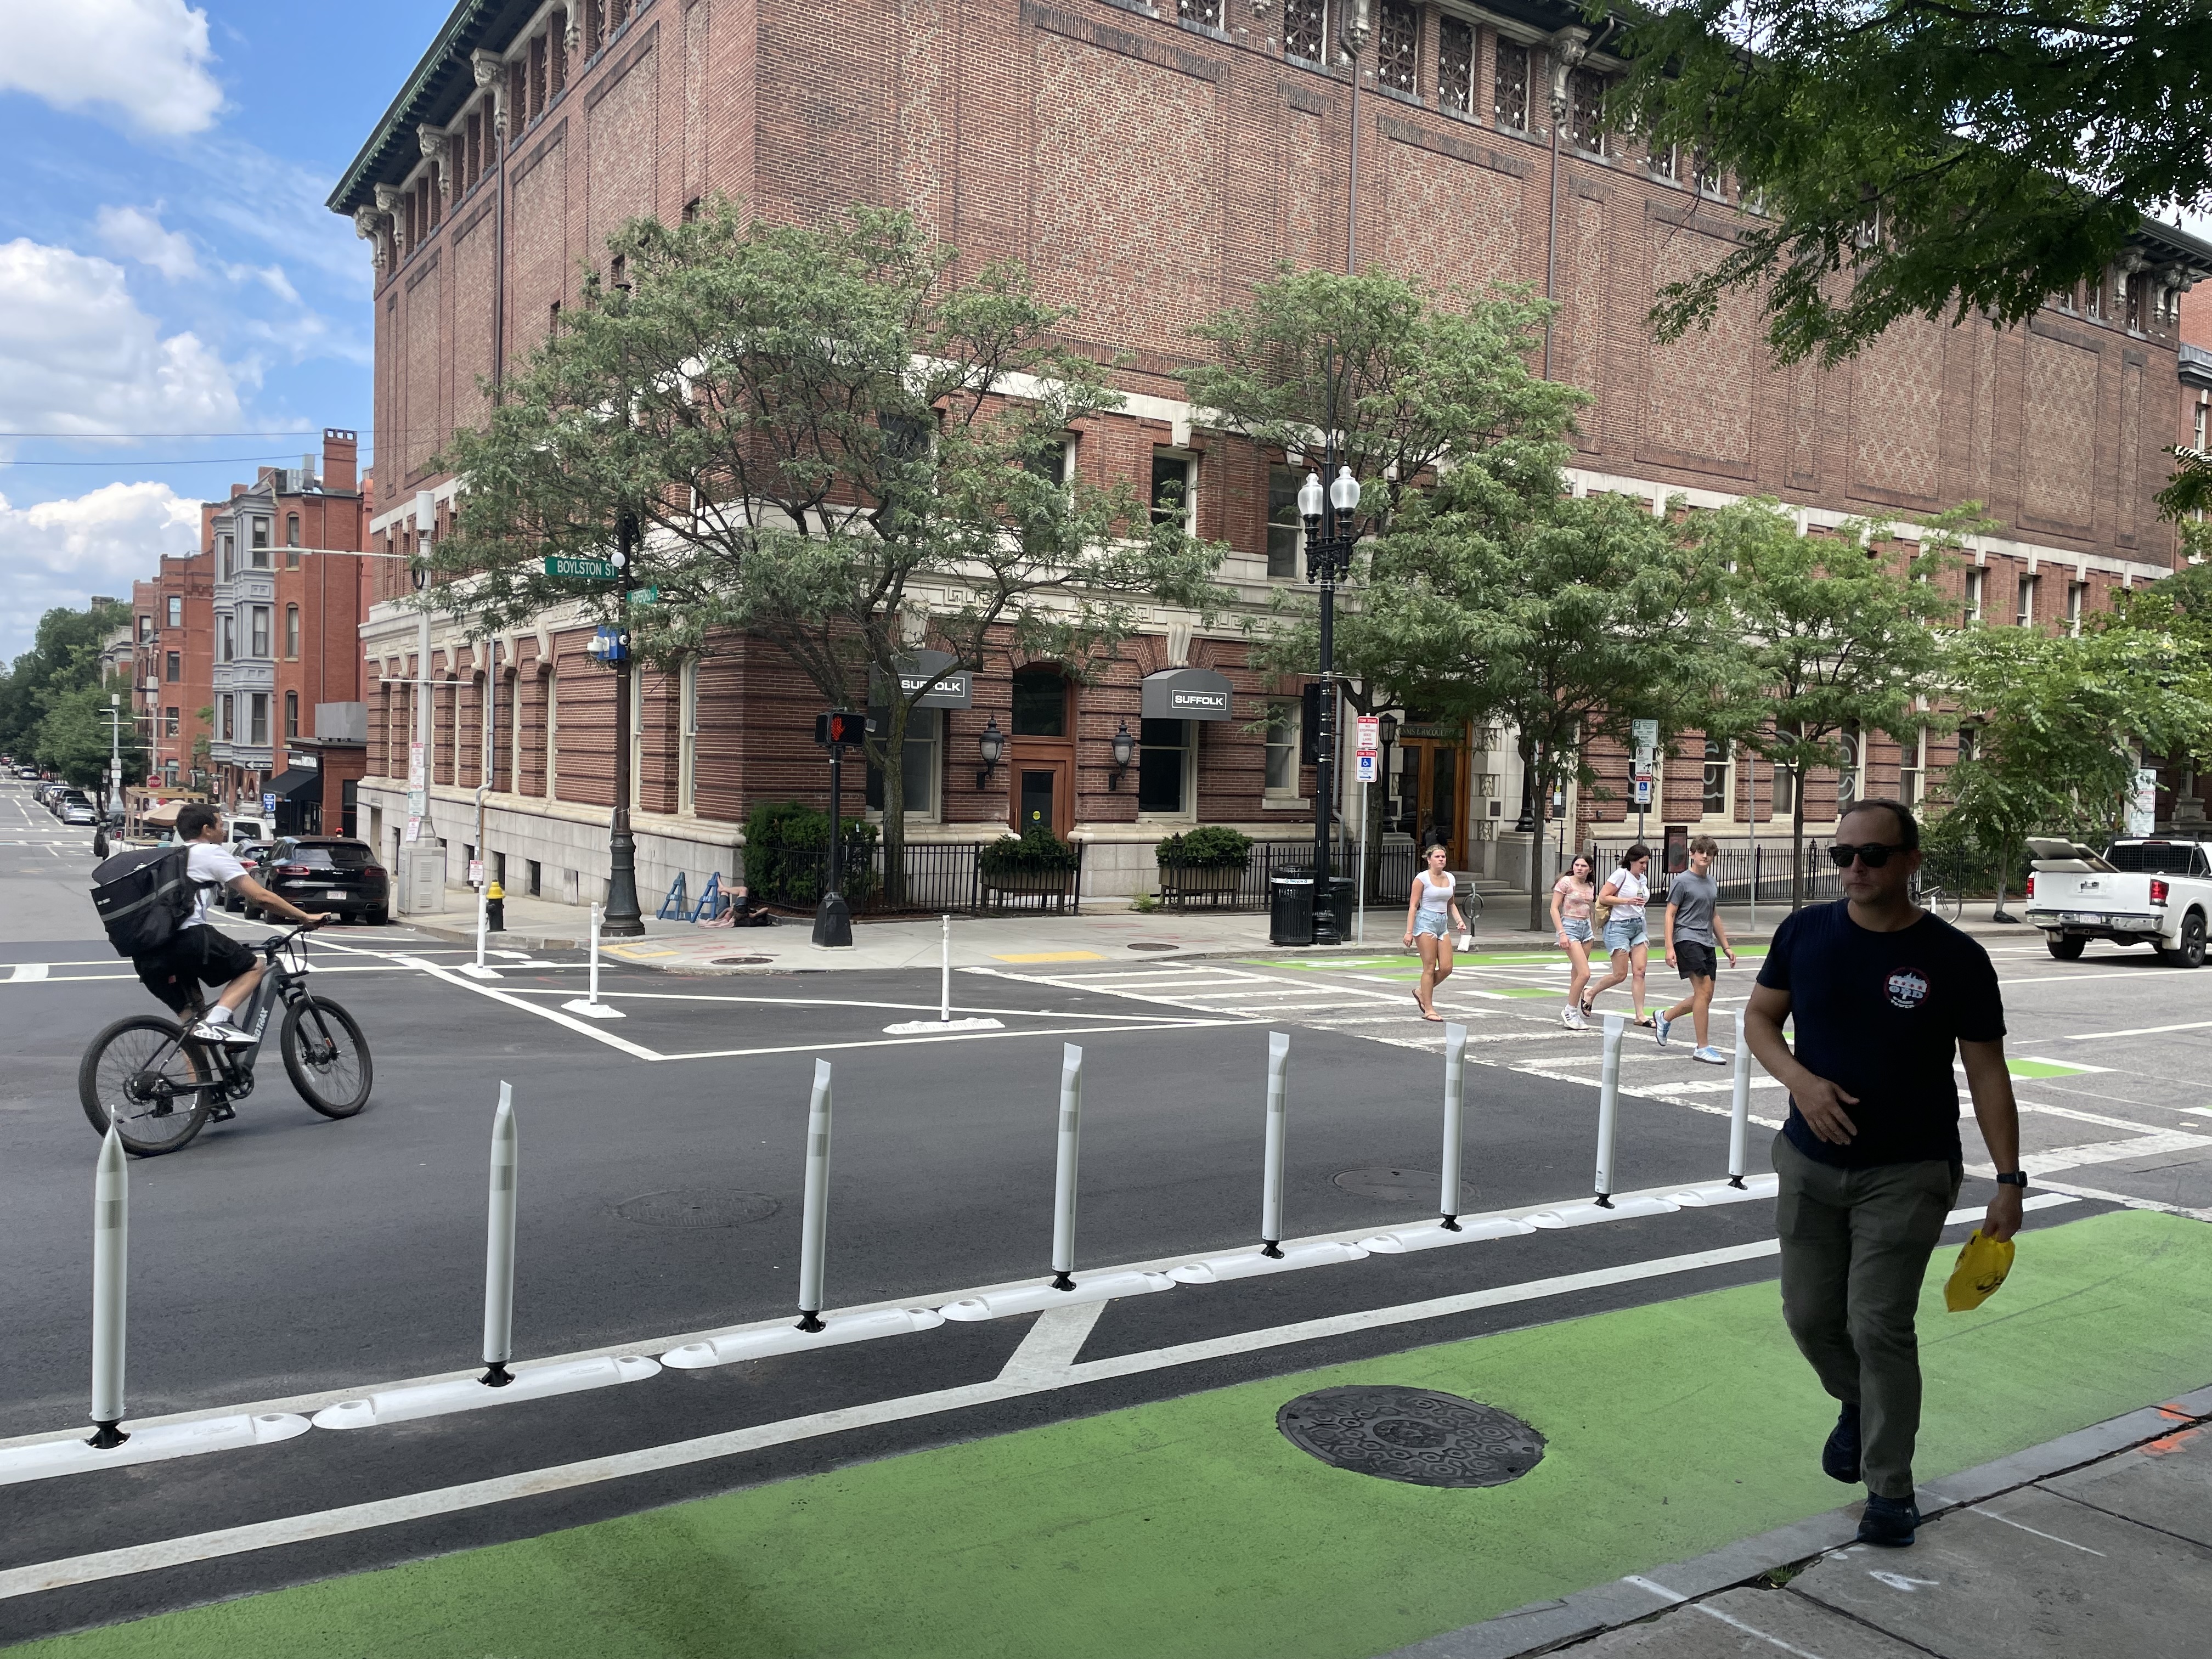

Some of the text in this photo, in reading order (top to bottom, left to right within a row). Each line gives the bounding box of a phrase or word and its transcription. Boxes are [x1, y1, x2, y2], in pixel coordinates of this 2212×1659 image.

[557, 560, 615, 577] BOYLSTON ST
[901, 680, 961, 691] SUFOLK
[1175, 695, 1223, 706] SUFFOLK
[1421, 728, 1447, 737] RACQUE
[1889, 985, 1923, 998] ORD
